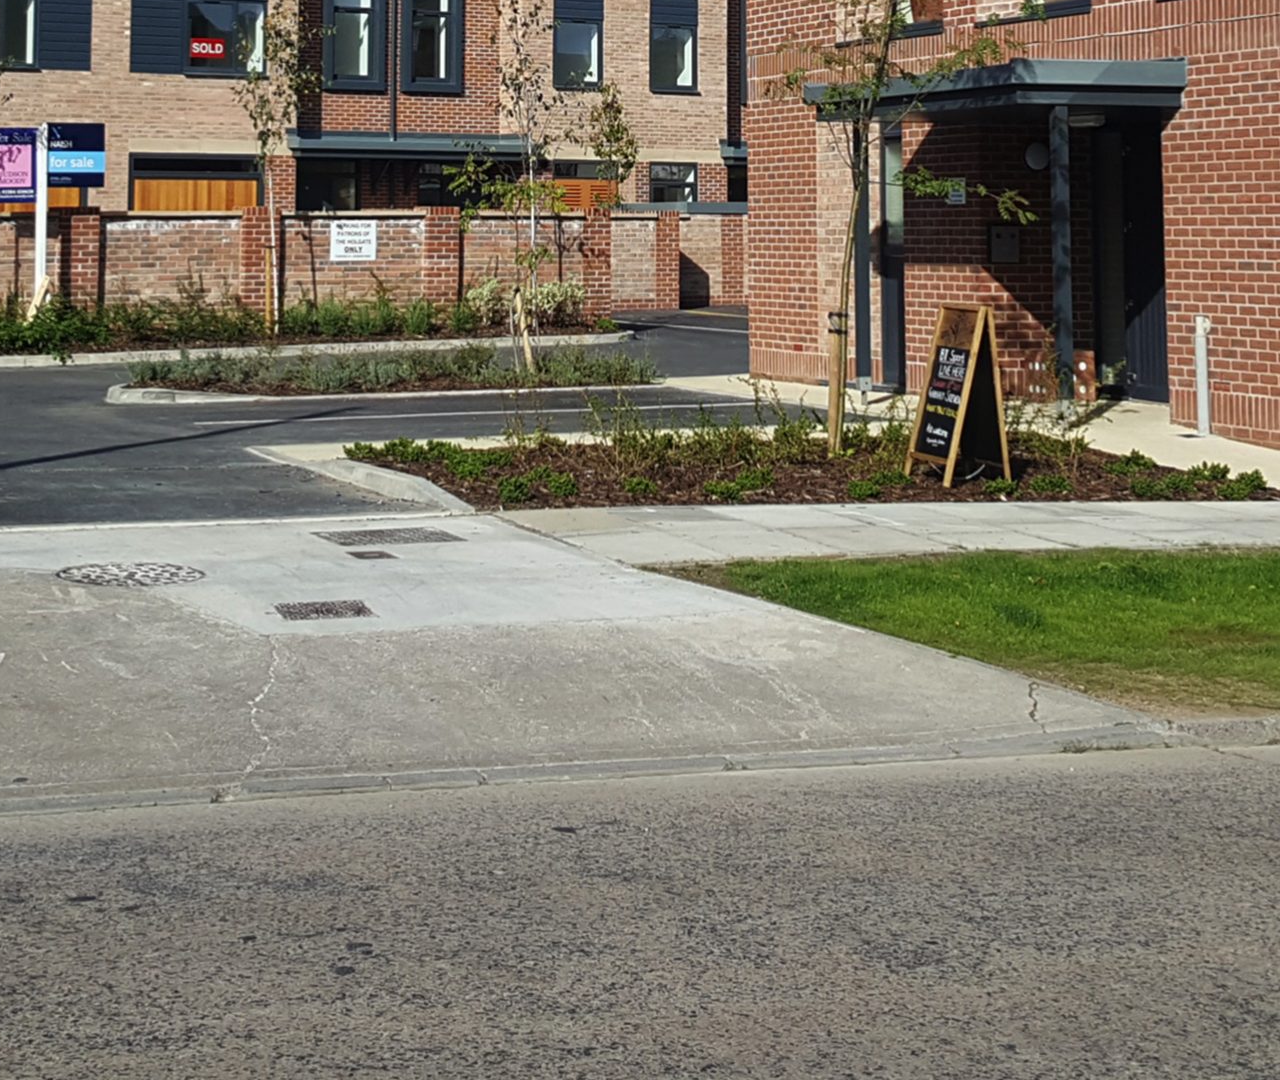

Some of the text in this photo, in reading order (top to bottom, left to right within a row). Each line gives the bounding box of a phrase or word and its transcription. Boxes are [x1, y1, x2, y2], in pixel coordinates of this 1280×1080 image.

[192, 42, 224, 54] SOLD
[12, 132, 32, 143] Sale
[50, 156, 95, 168] for sale
[344, 246, 363, 254] ONLY
